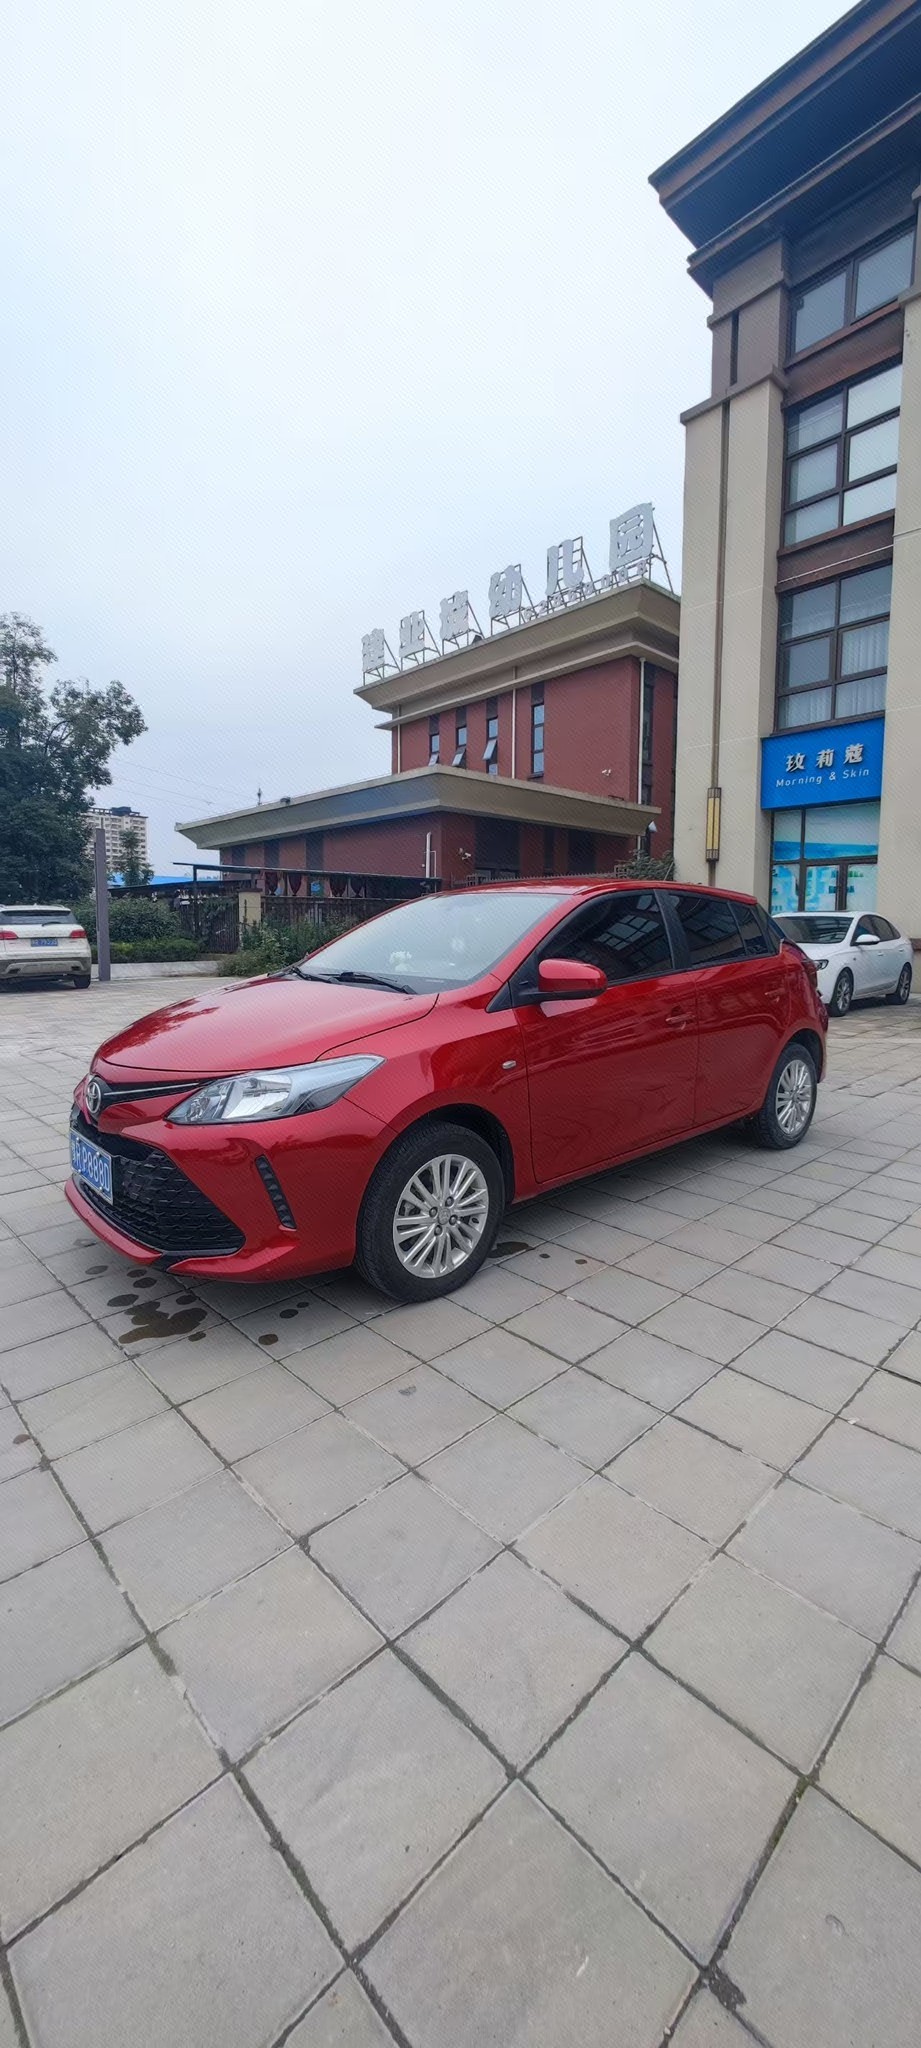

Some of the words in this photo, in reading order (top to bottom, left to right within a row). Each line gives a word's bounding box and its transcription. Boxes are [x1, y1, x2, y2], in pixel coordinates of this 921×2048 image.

[785, 743, 864, 773] 玫莉蔻
[775, 775, 822, 788] Morning
[828, 771, 836, 781] &
[842, 768, 870, 779] Skin
